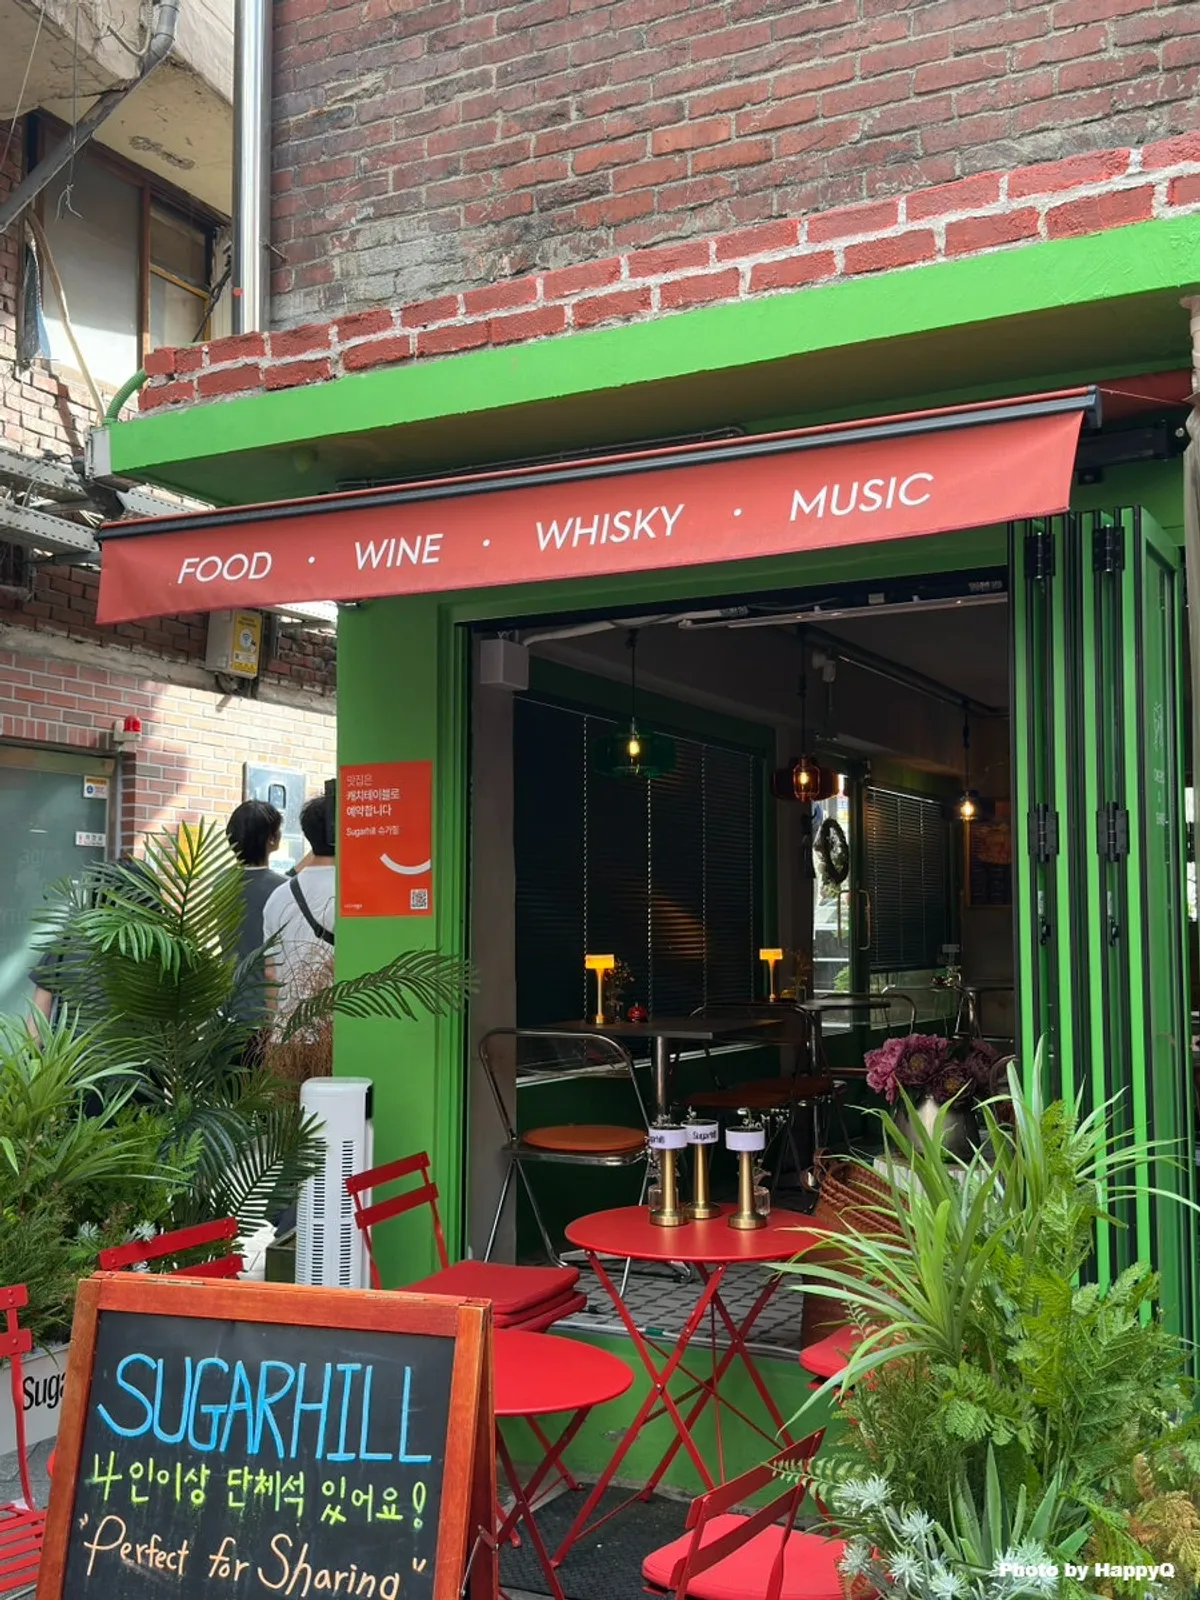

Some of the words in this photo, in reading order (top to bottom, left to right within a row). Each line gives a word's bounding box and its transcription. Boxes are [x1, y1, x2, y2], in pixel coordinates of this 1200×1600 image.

[177, 551, 272, 584] FOOD
[354, 533, 443, 571] WINE
[535, 503, 685, 552] WHISKY
[790, 471, 933, 522] MUSIC
[346, 774, 373, 787] 맛집은
[346, 788, 401, 801] 캐치테이블로
[346, 804, 392, 818] 예약합니다
[97, 1353, 432, 1462] SUGARHILL
[88, 1451, 211, 1504] 4인이상
[227, 1466, 305, 1517] 단체석
[321, 1480, 428, 1529] 있어요!
[208, 1537, 249, 1581] for
